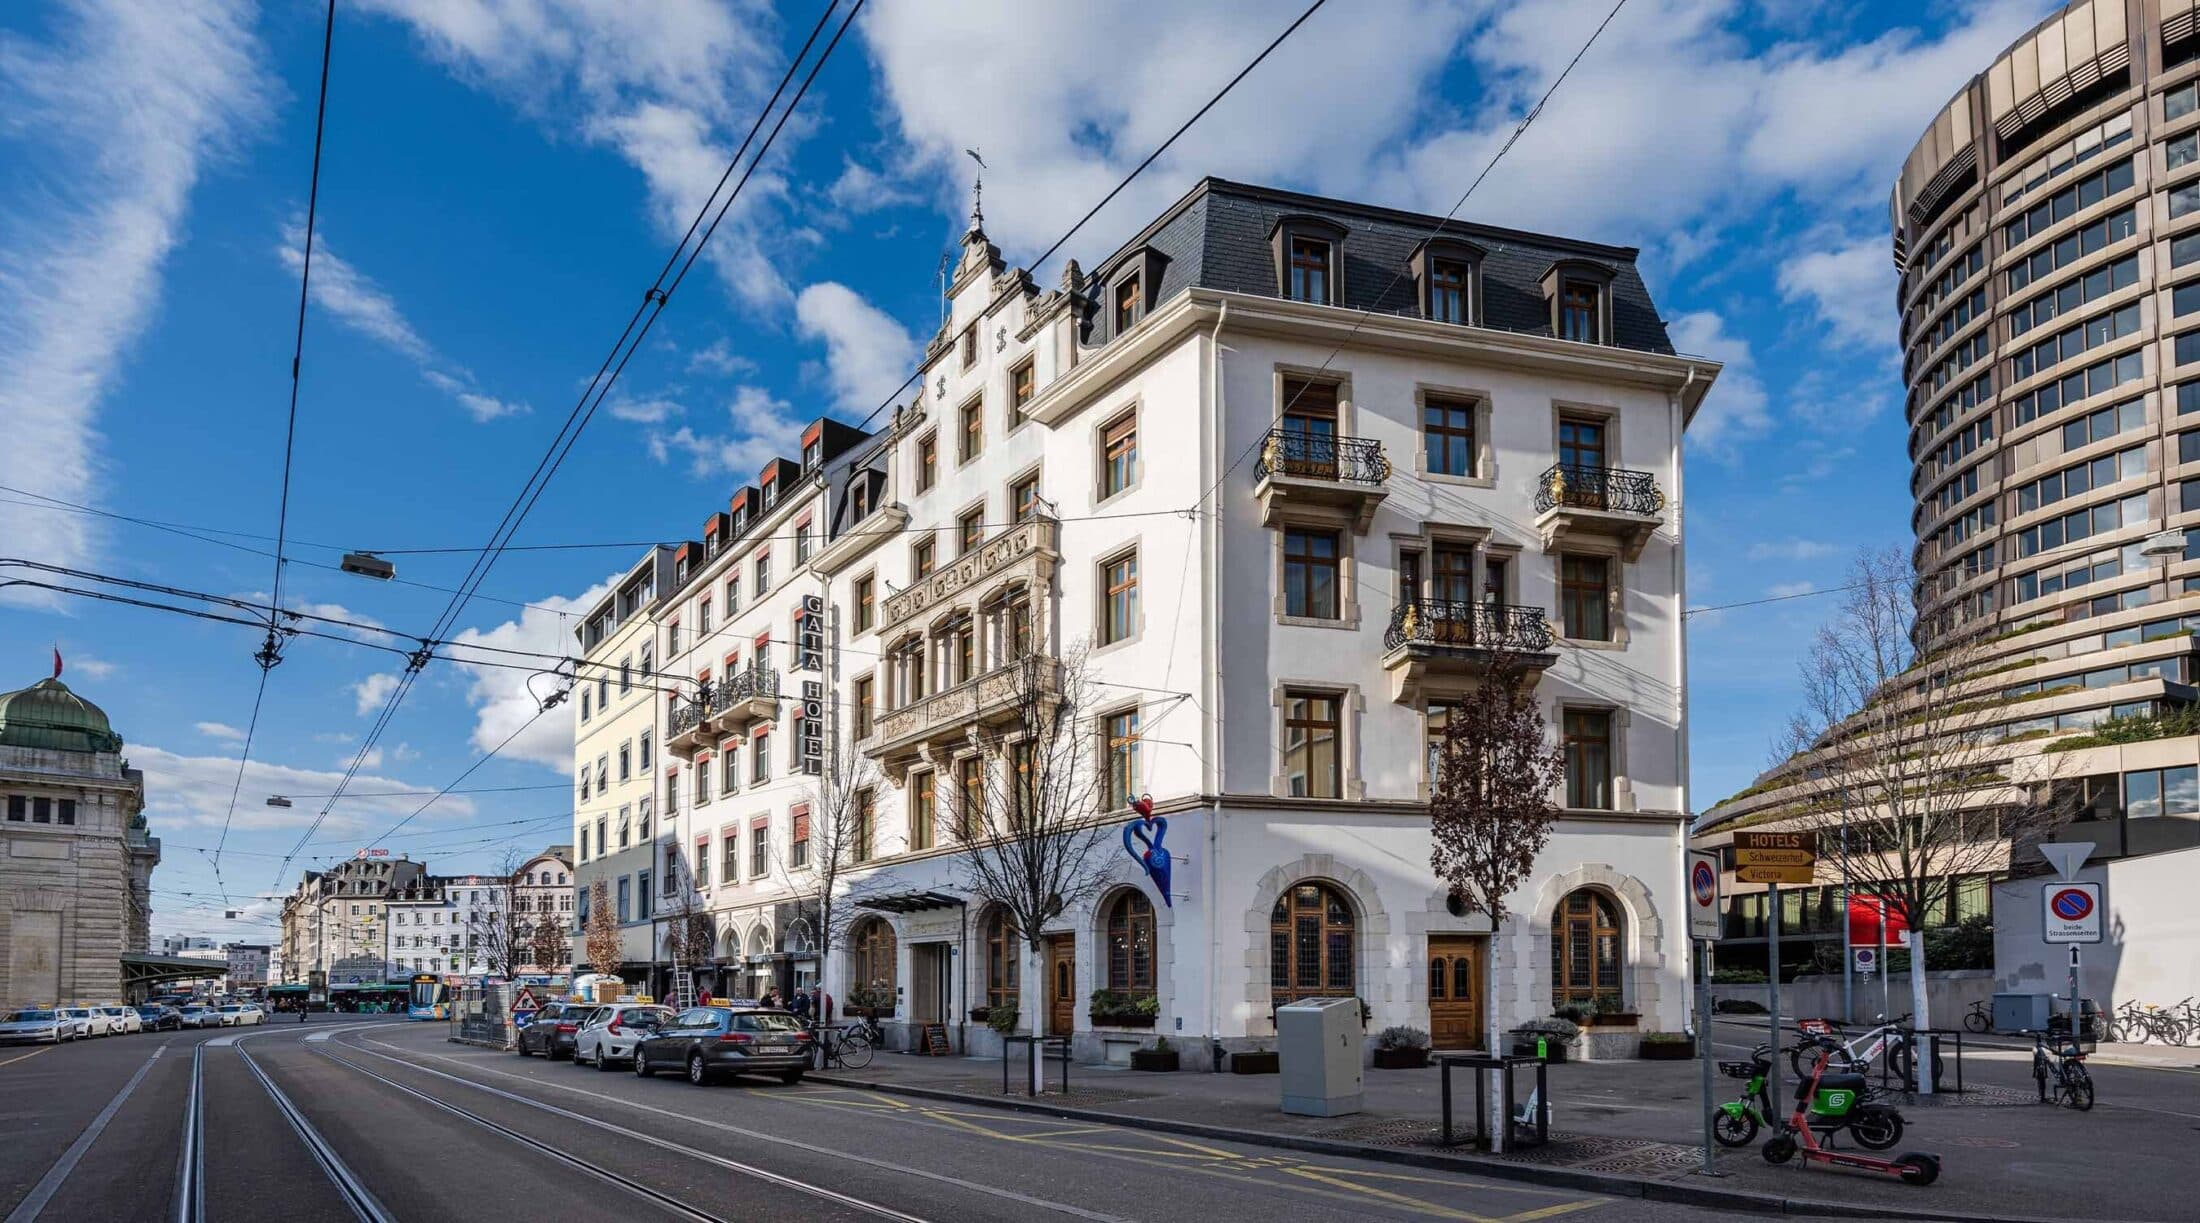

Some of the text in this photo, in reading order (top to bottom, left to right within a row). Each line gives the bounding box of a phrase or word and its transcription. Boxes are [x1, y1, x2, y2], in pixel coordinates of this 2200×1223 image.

[806, 598, 821, 774] GAIA HOTEL
[1749, 834, 1800, 847] HOTELS
[1749, 852, 1803, 862] Schweizerhof
[1750, 869, 1782, 879] Victoria
